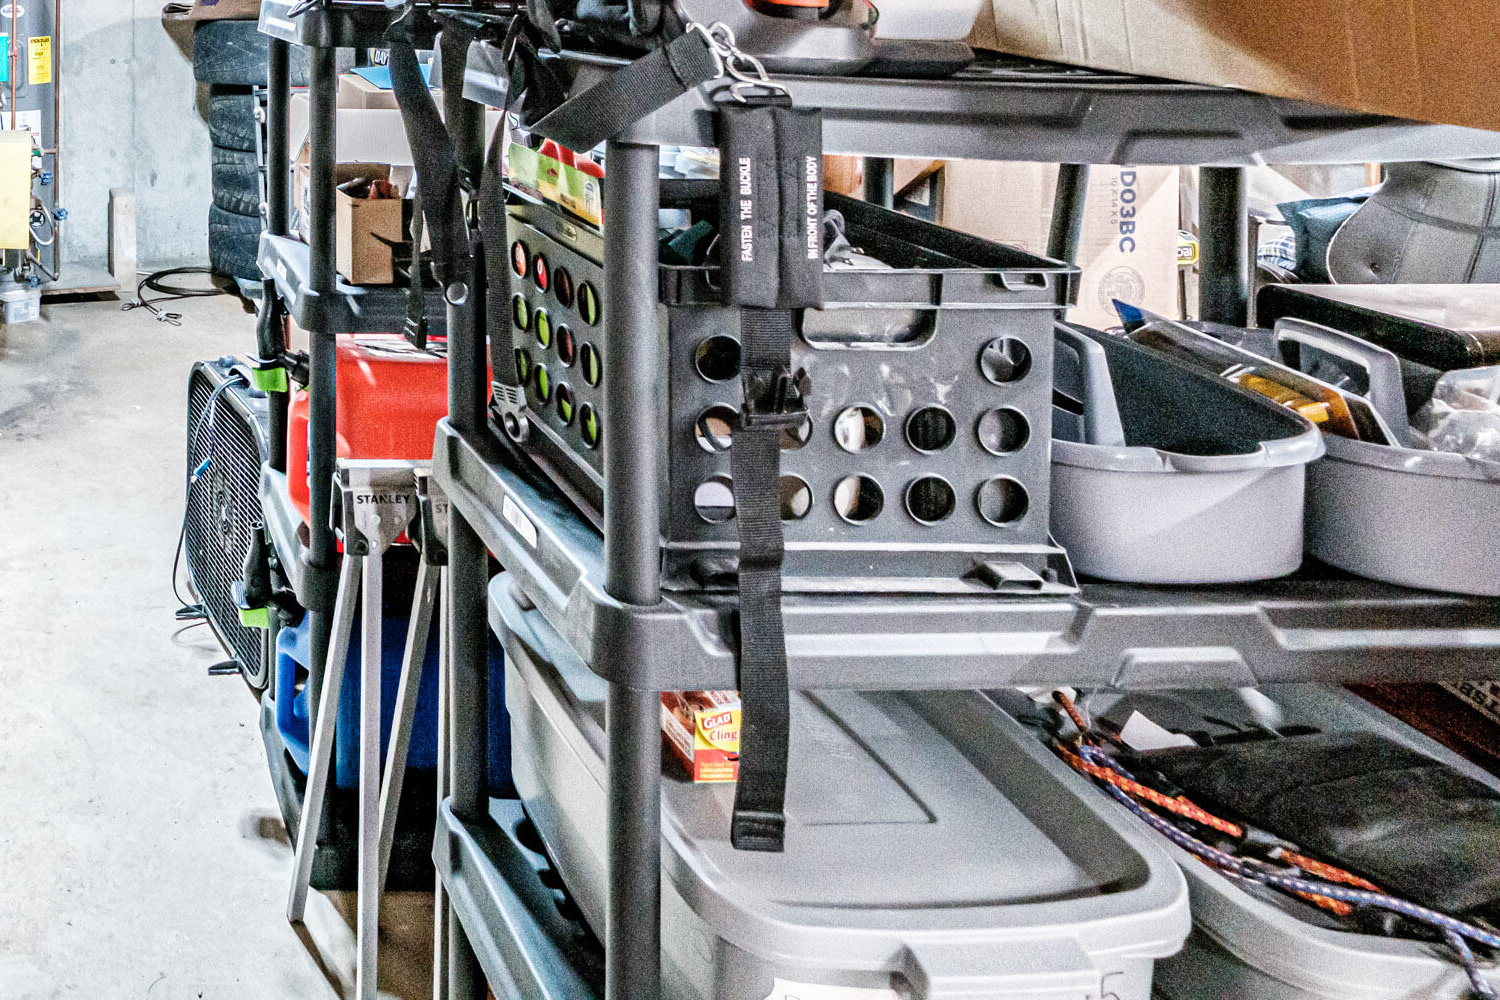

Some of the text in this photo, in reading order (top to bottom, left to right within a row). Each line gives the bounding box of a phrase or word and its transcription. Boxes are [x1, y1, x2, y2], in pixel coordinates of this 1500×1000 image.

[739, 157, 753, 262] FASTEN THE BUCKLE
[806, 156, 818, 259] IN FRONT OF THE BODY
[356, 494, 411, 504] STANLEY
[435, 504, 449, 514] ST
[703, 713, 731, 729] GLAD
[709, 729, 738, 741] Cling
